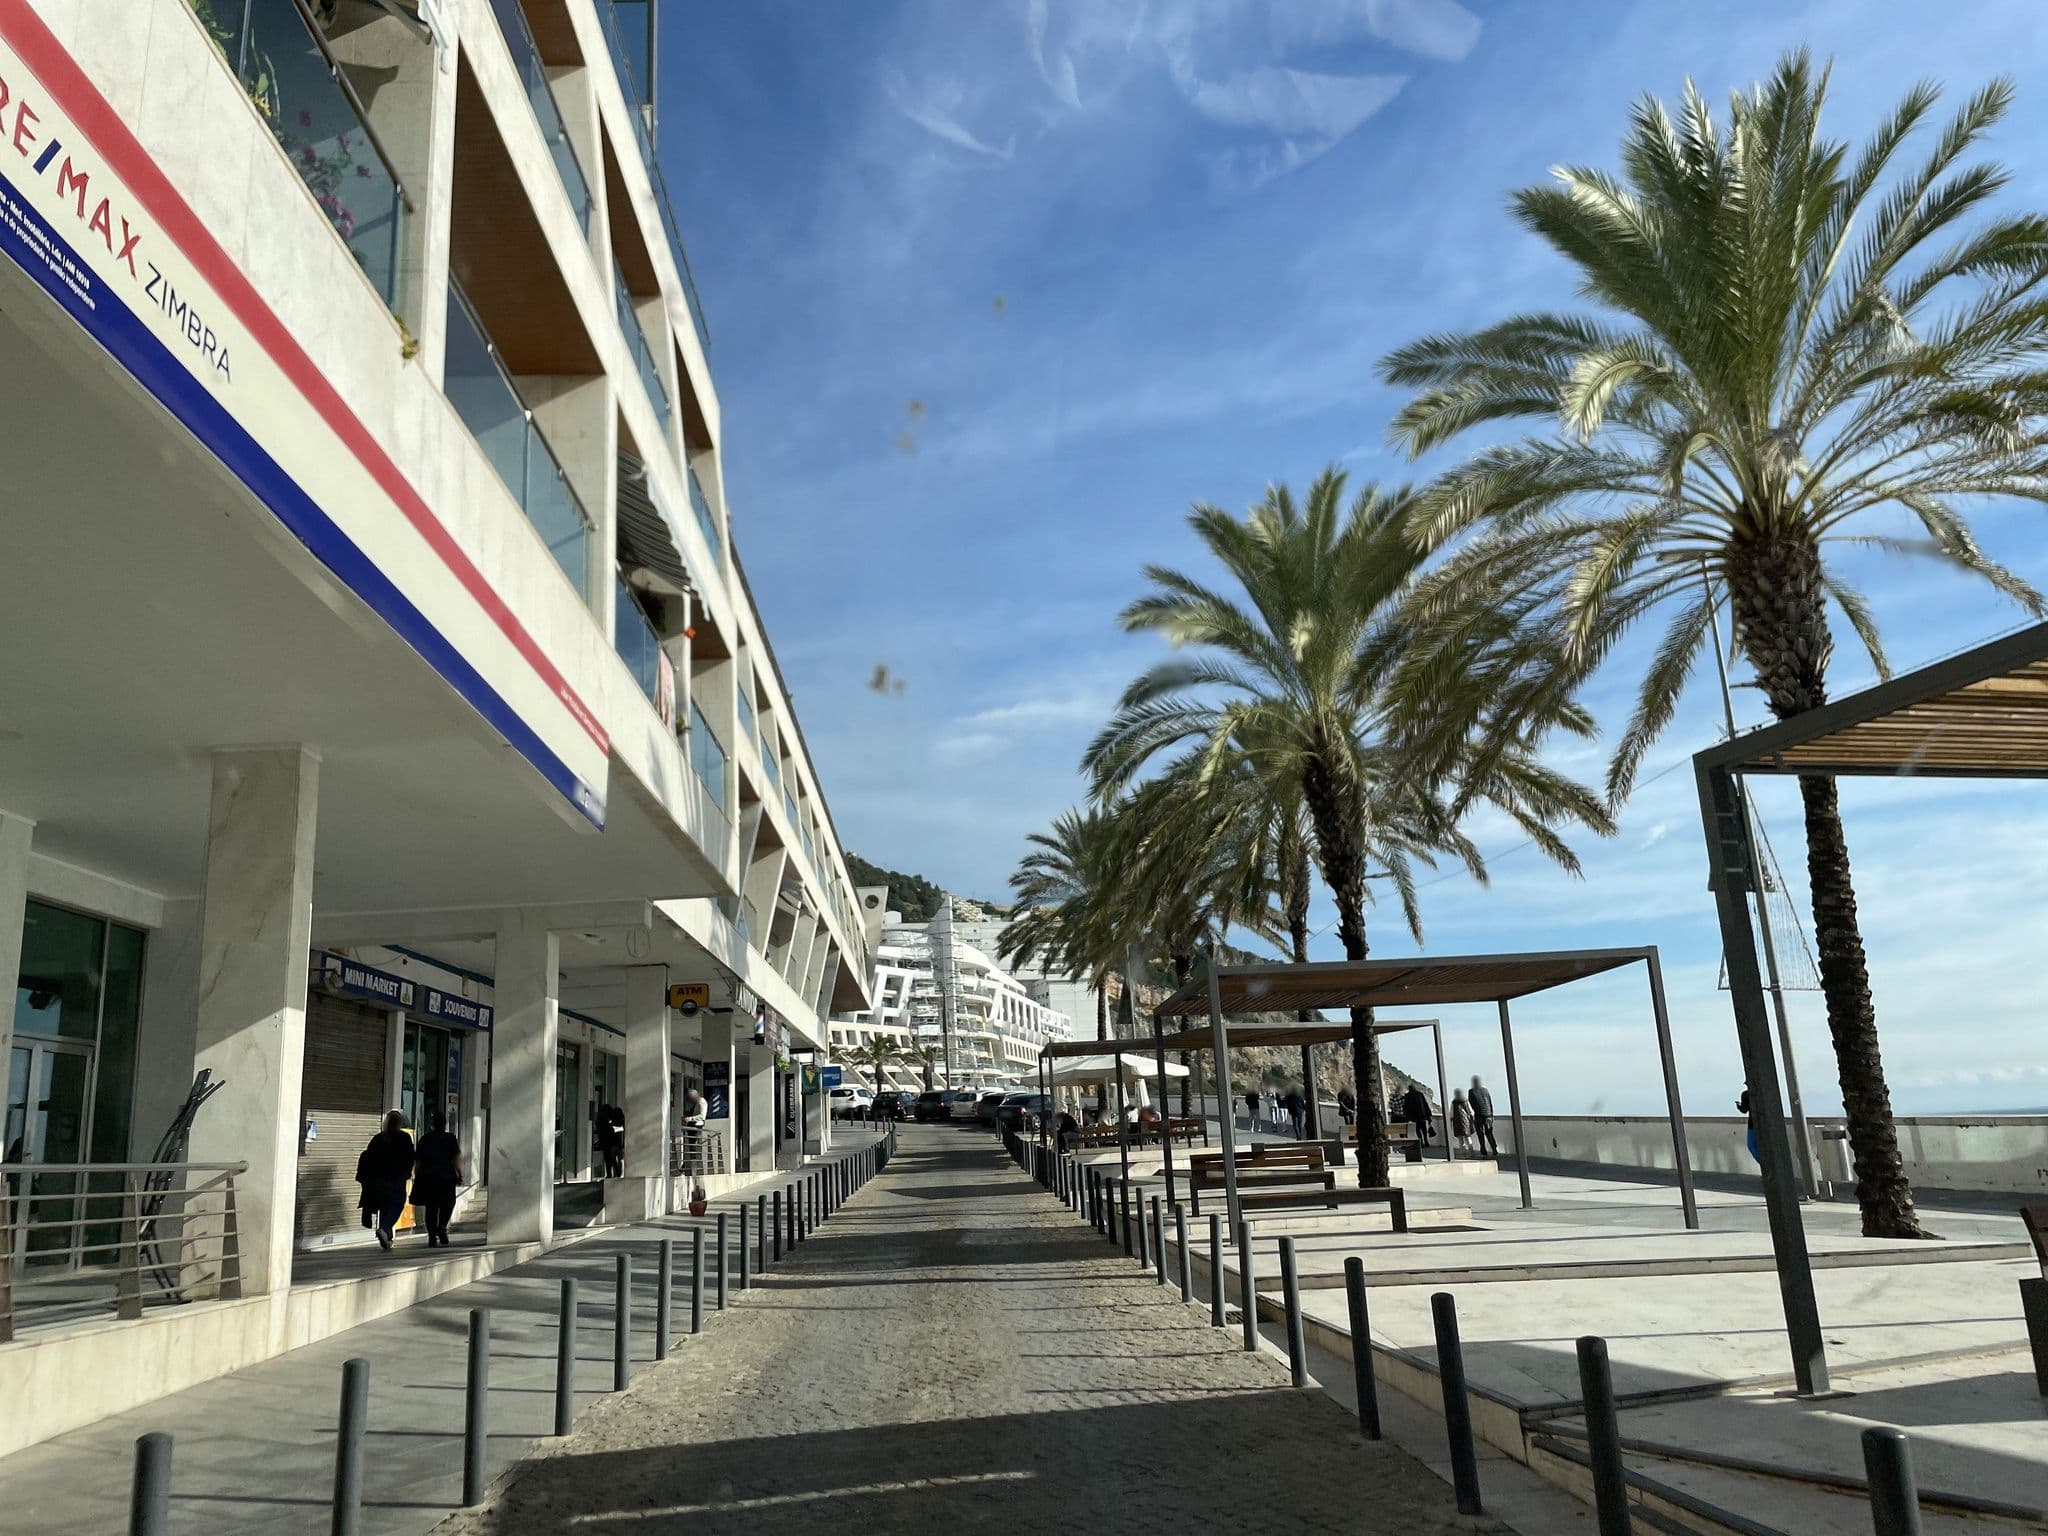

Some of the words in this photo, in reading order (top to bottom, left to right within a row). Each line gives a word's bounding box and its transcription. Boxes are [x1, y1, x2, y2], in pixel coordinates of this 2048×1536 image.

[16, 226, 46, 260] propriedade
[66, 273, 96, 311] independente
[145, 261, 231, 384] ZIMBRA
[345, 967, 365, 987] MINI
[365, 973, 399, 997] MARKET
[676, 986, 702, 996] ATM
[444, 999, 477, 1021] SOUVENIRS
